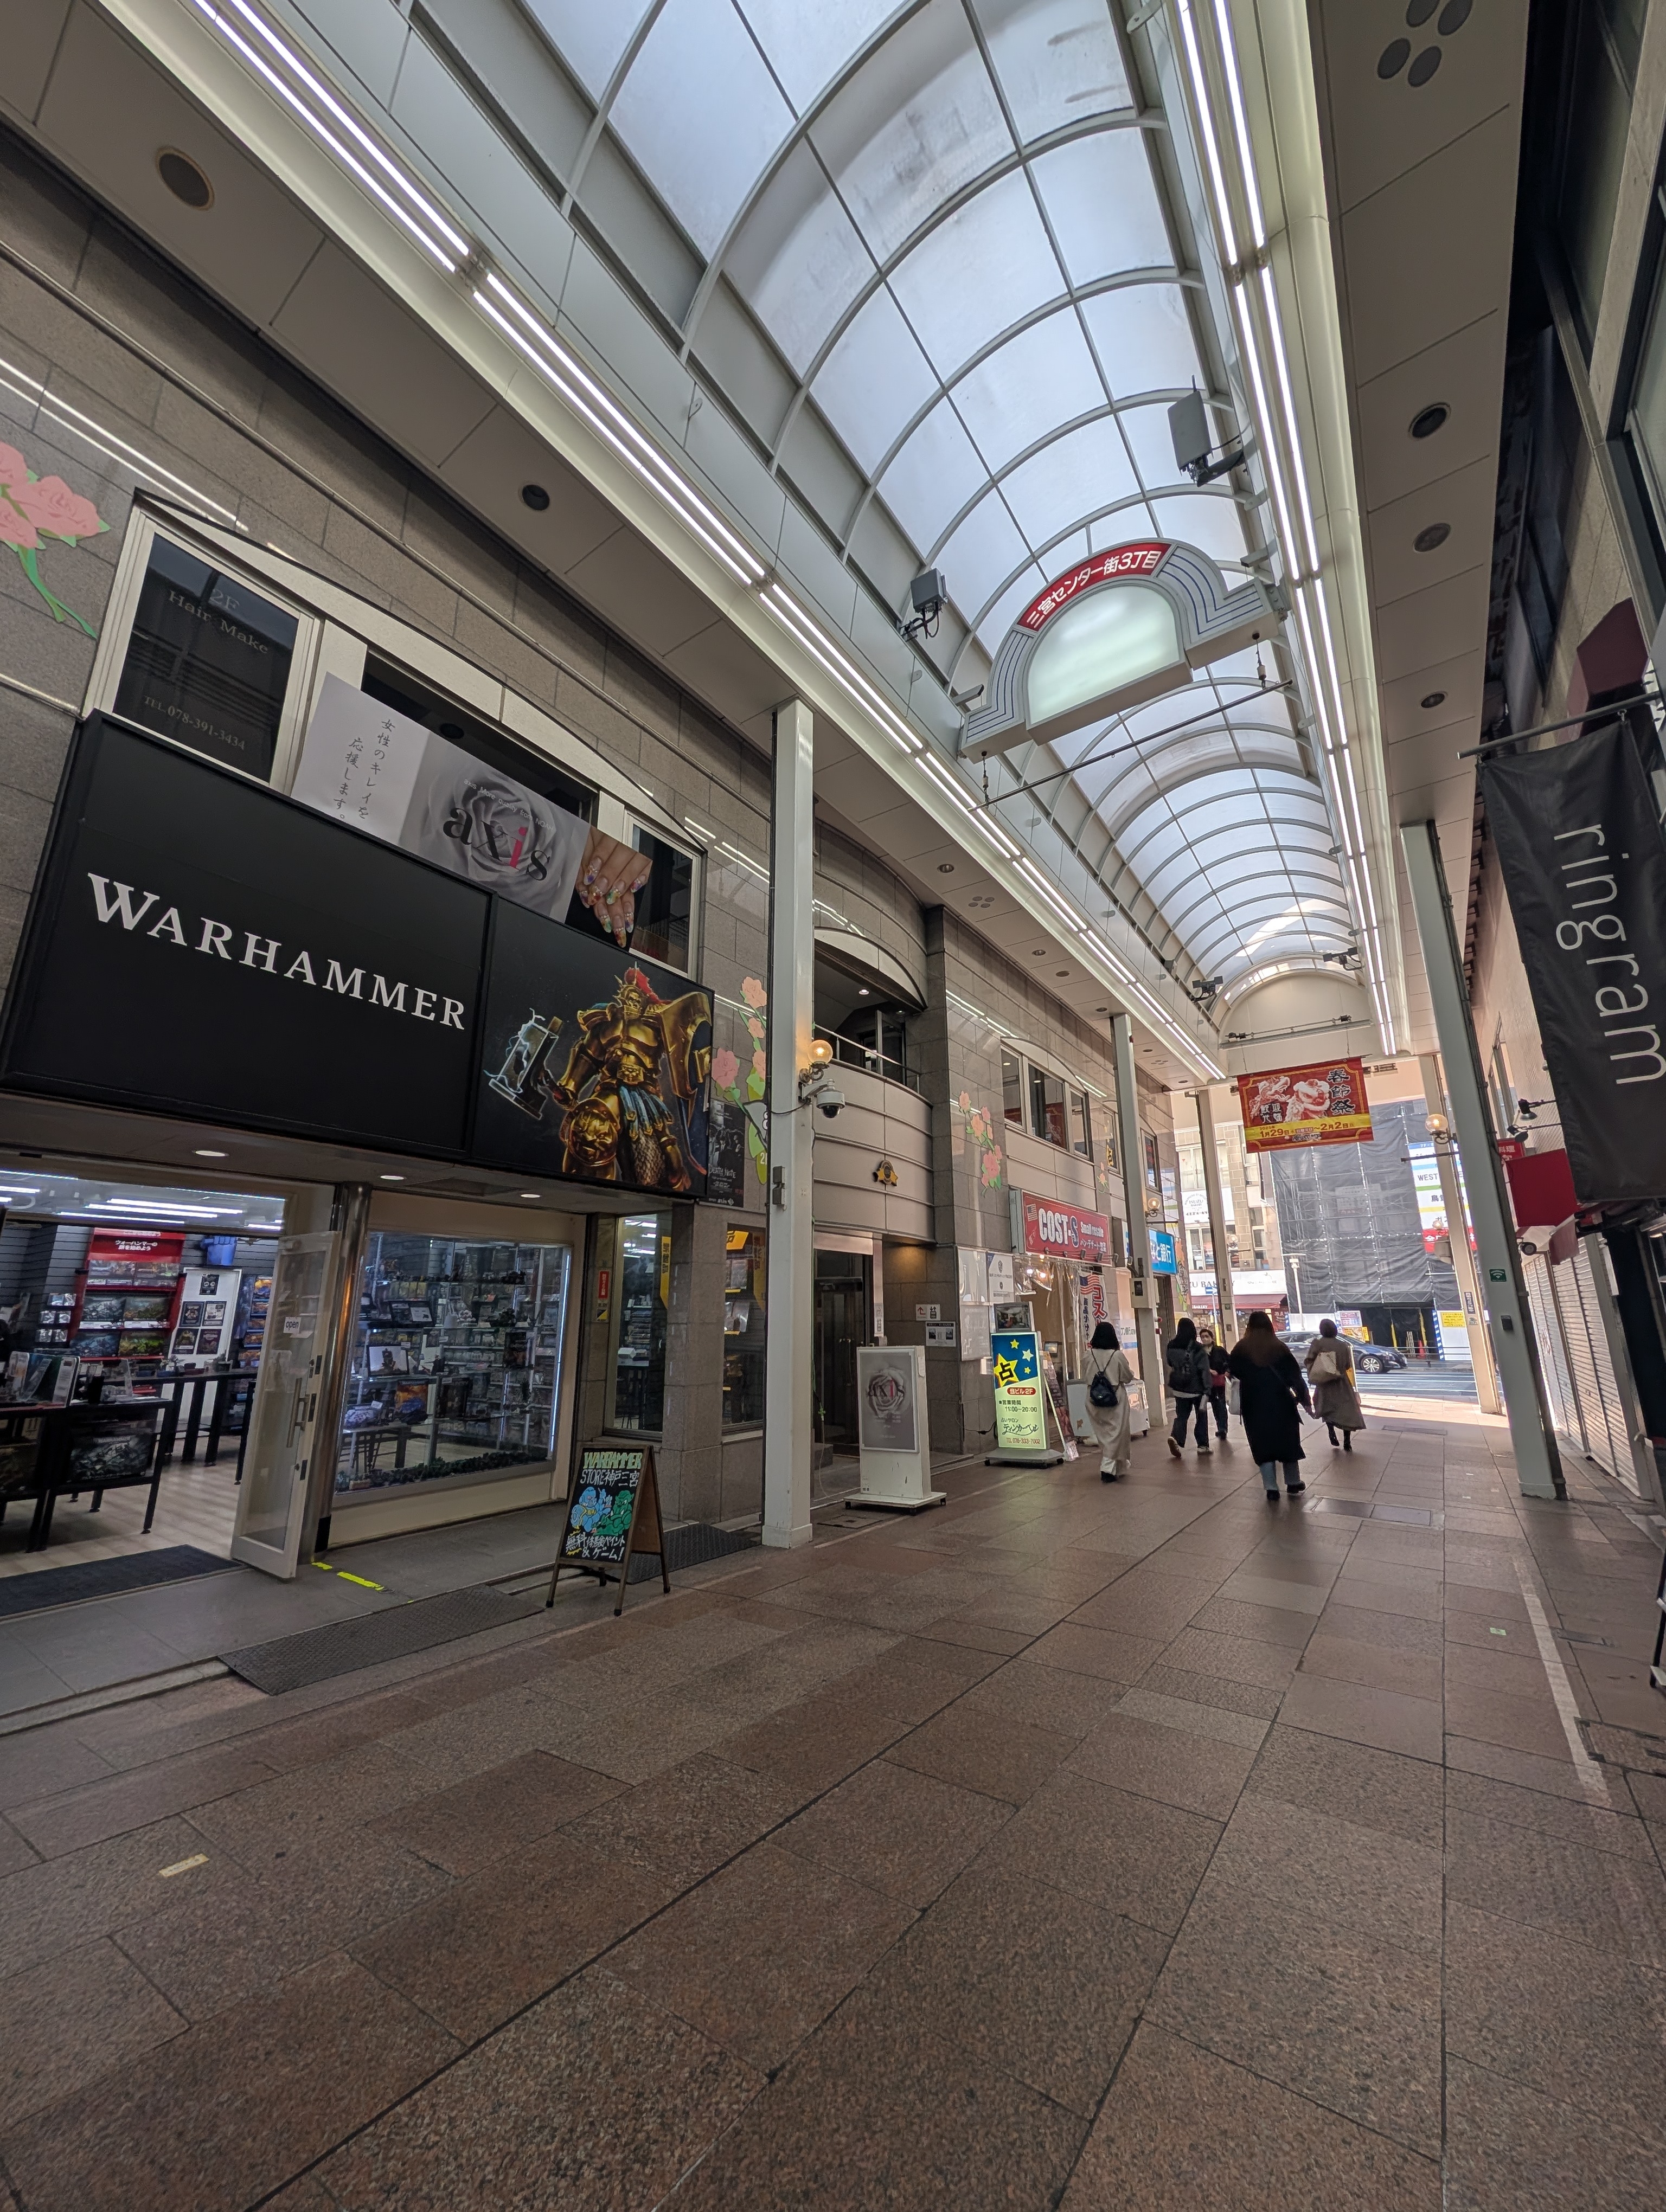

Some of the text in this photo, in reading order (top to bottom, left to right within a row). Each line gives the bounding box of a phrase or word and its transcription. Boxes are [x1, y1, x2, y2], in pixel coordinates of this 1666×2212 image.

[210, 589, 240, 609] 2F
[1027, 551, 1162, 628] 三宮センター街3丁目
[167, 590, 269, 654] Hair Make
[334, 737, 363, 819] 応援します。
[358, 719, 395, 819] 女性のキレイを
[464, 779, 477, 789] axis
[479, 786, 496, 800] More
[498, 798, 518, 813] quality
[519, 809, 533, 821] from
[443, 807, 551, 881] axis
[87, 872, 465, 1030] WARHAMMER
[1554, 824, 1666, 1084] ringram
[1038, 1208, 1079, 1248] COST-S
[1080, 1221, 1092, 1234] Small
[285, 1321, 299, 1331] open
[999, 1362, 1014, 1381] 占
[583, 1451, 643, 1469] WARHAMMER
[581, 1546, 591, 1558] &
